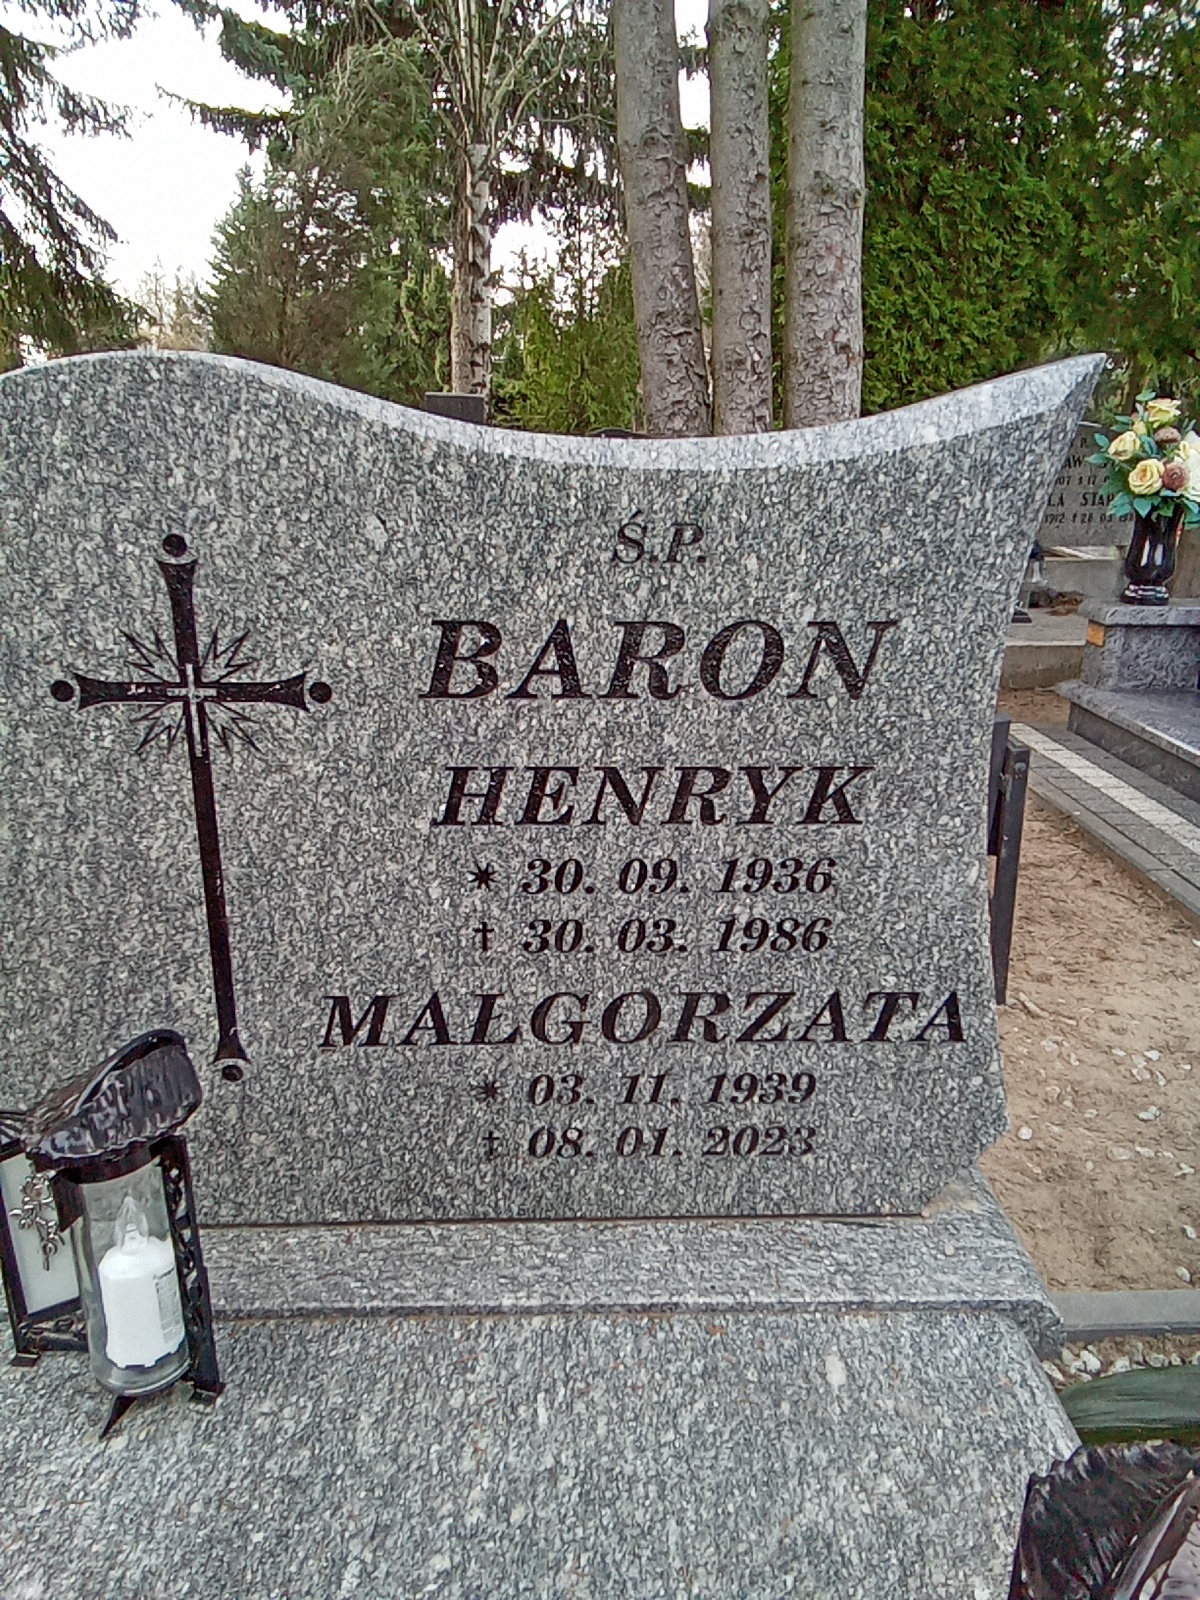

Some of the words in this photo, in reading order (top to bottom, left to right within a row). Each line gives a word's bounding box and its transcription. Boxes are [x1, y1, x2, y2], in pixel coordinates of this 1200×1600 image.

[418, 618, 898, 701] BARON
[432, 765, 876, 827] HENRYK
[521, 857, 595, 895] 30.
[618, 857, 690, 895] 09.
[714, 857, 837, 895] 1936
[522, 917, 595, 954] 30.
[616, 917, 688, 954] 03.
[712, 916, 834, 953] 1986
[318, 990, 968, 1048] MAŁGORZATA
[528, 1072, 596, 1106] 03.
[619, 1072, 681, 1105] 11.
[703, 1071, 818, 1105] 1939
[527, 1125, 594, 1159] 08.
[615, 1124, 683, 1158] 01.
[701, 1124, 818, 1158] 2023
